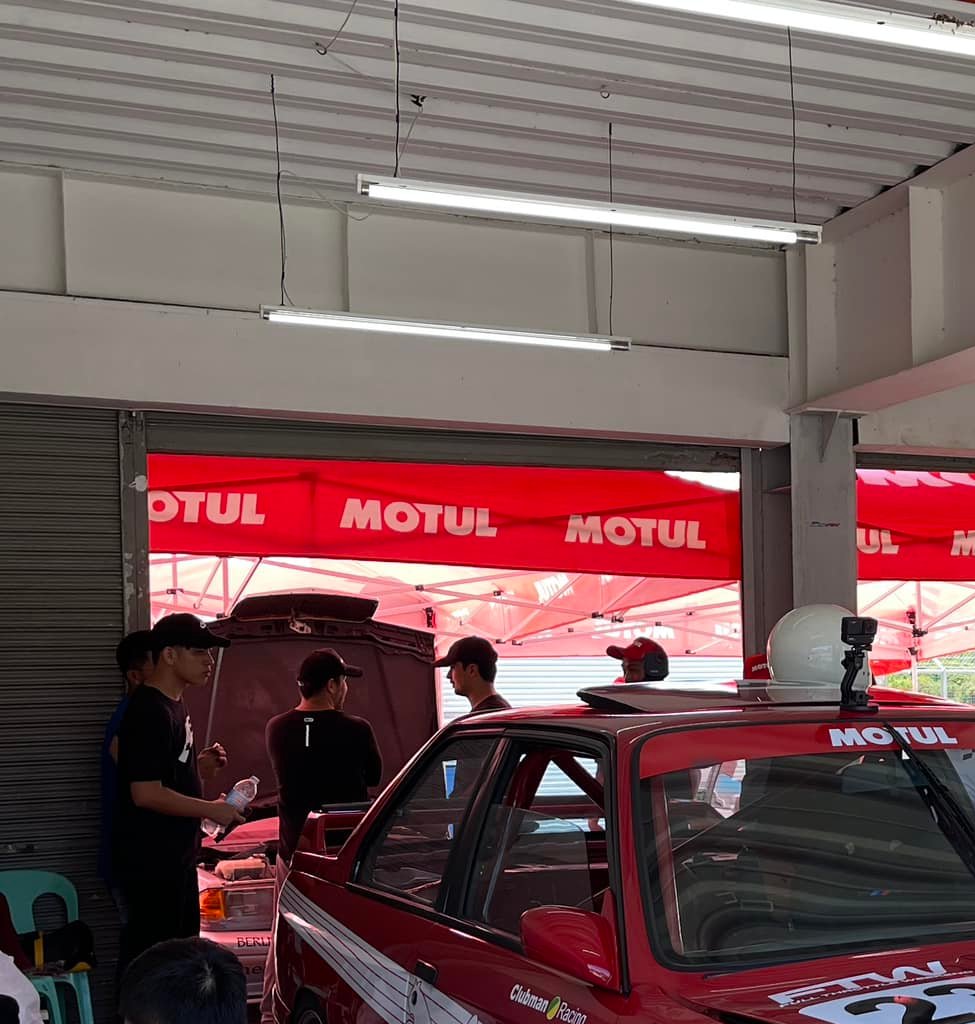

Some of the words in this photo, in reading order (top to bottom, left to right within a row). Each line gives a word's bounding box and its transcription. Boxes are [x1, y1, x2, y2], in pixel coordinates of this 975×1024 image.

[148, 490, 265, 525] OTUL
[340, 498, 497, 537] MOTUL
[564, 514, 706, 550] MOTUL
[828, 726, 957, 747] MOTUL
[510, 984, 549, 1013] Clubman
